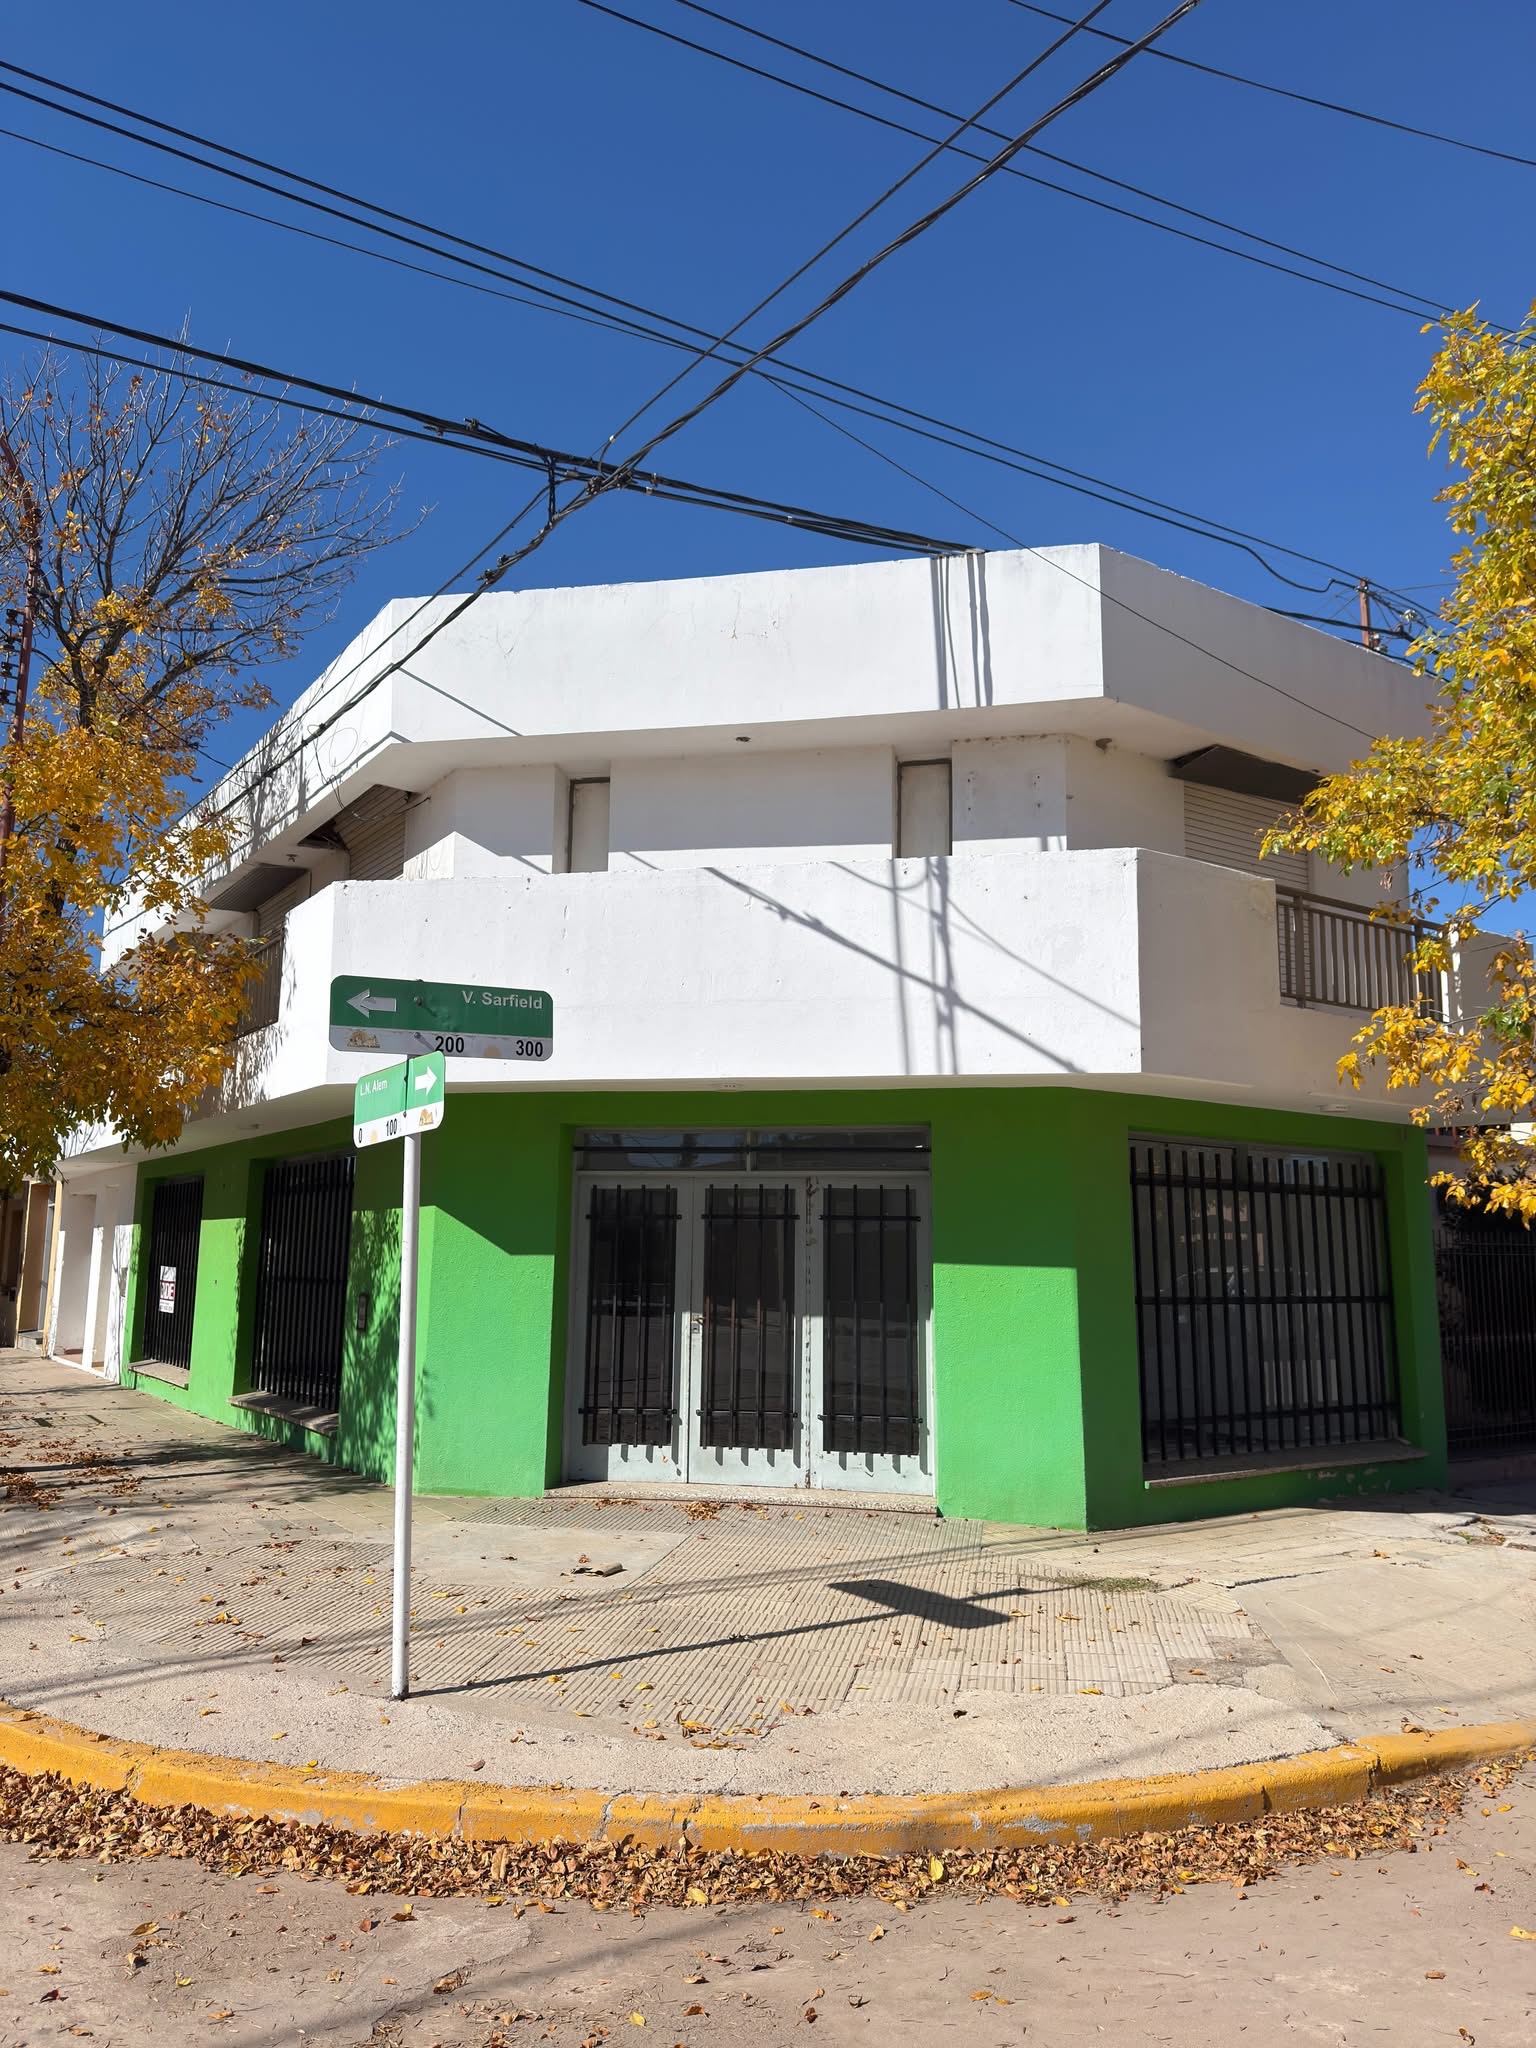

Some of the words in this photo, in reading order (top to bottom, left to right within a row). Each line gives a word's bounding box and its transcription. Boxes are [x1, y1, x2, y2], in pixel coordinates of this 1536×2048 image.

[462, 990, 477, 1004] V.
[481, 992, 543, 1009] Sarfield
[435, 1035, 465, 1053] 200
[515, 1040, 543, 1057] 300
[372, 1079, 388, 1092] Alem
[358, 1128, 363, 1143] 0
[386, 1118, 398, 1136] 100
